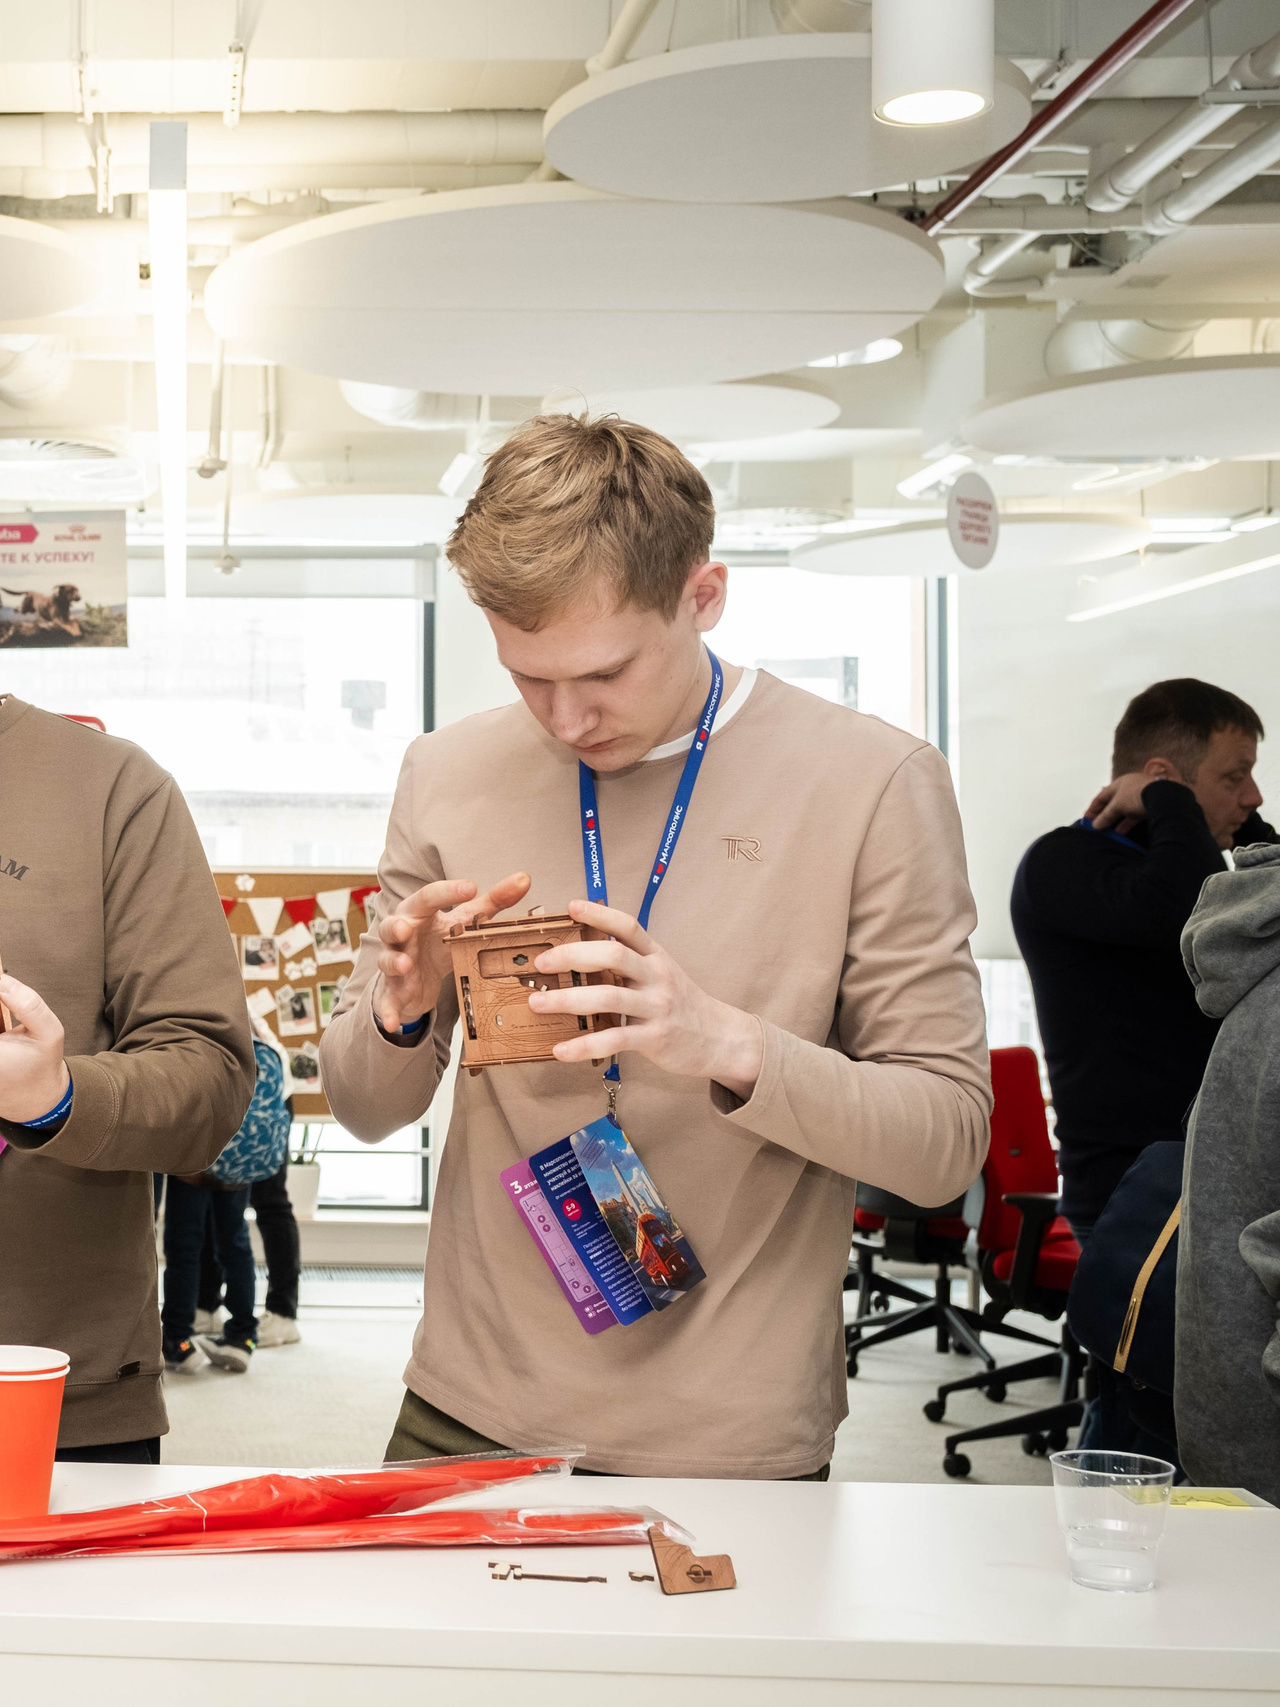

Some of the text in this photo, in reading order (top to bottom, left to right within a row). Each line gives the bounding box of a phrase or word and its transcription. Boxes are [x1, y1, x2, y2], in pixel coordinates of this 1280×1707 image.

[21, 552, 31, 563] К
[35, 551, 95, 564] УСПЕХУ!
[509, 1180, 523, 1195] 3
[566, 1203, 576, 1211] 5-9
